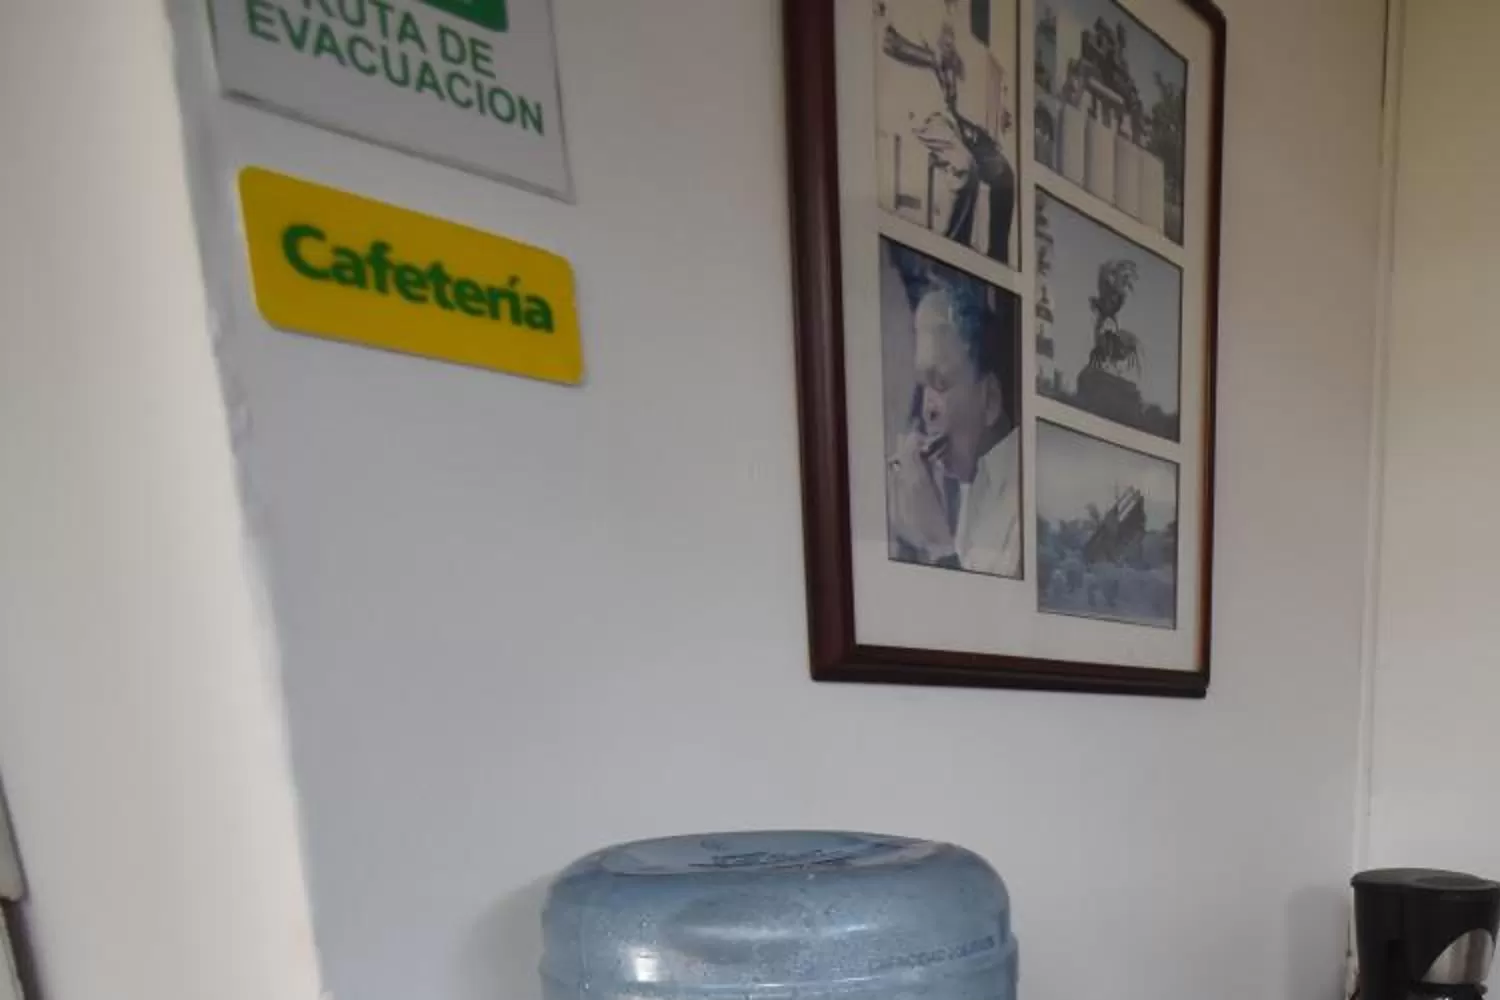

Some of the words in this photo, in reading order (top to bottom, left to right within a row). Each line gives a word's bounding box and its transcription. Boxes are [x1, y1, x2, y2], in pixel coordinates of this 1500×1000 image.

[246, 0, 545, 136] EVACUACION
[437, 23, 496, 80] DE
[281, 223, 556, 335] Cafetería
